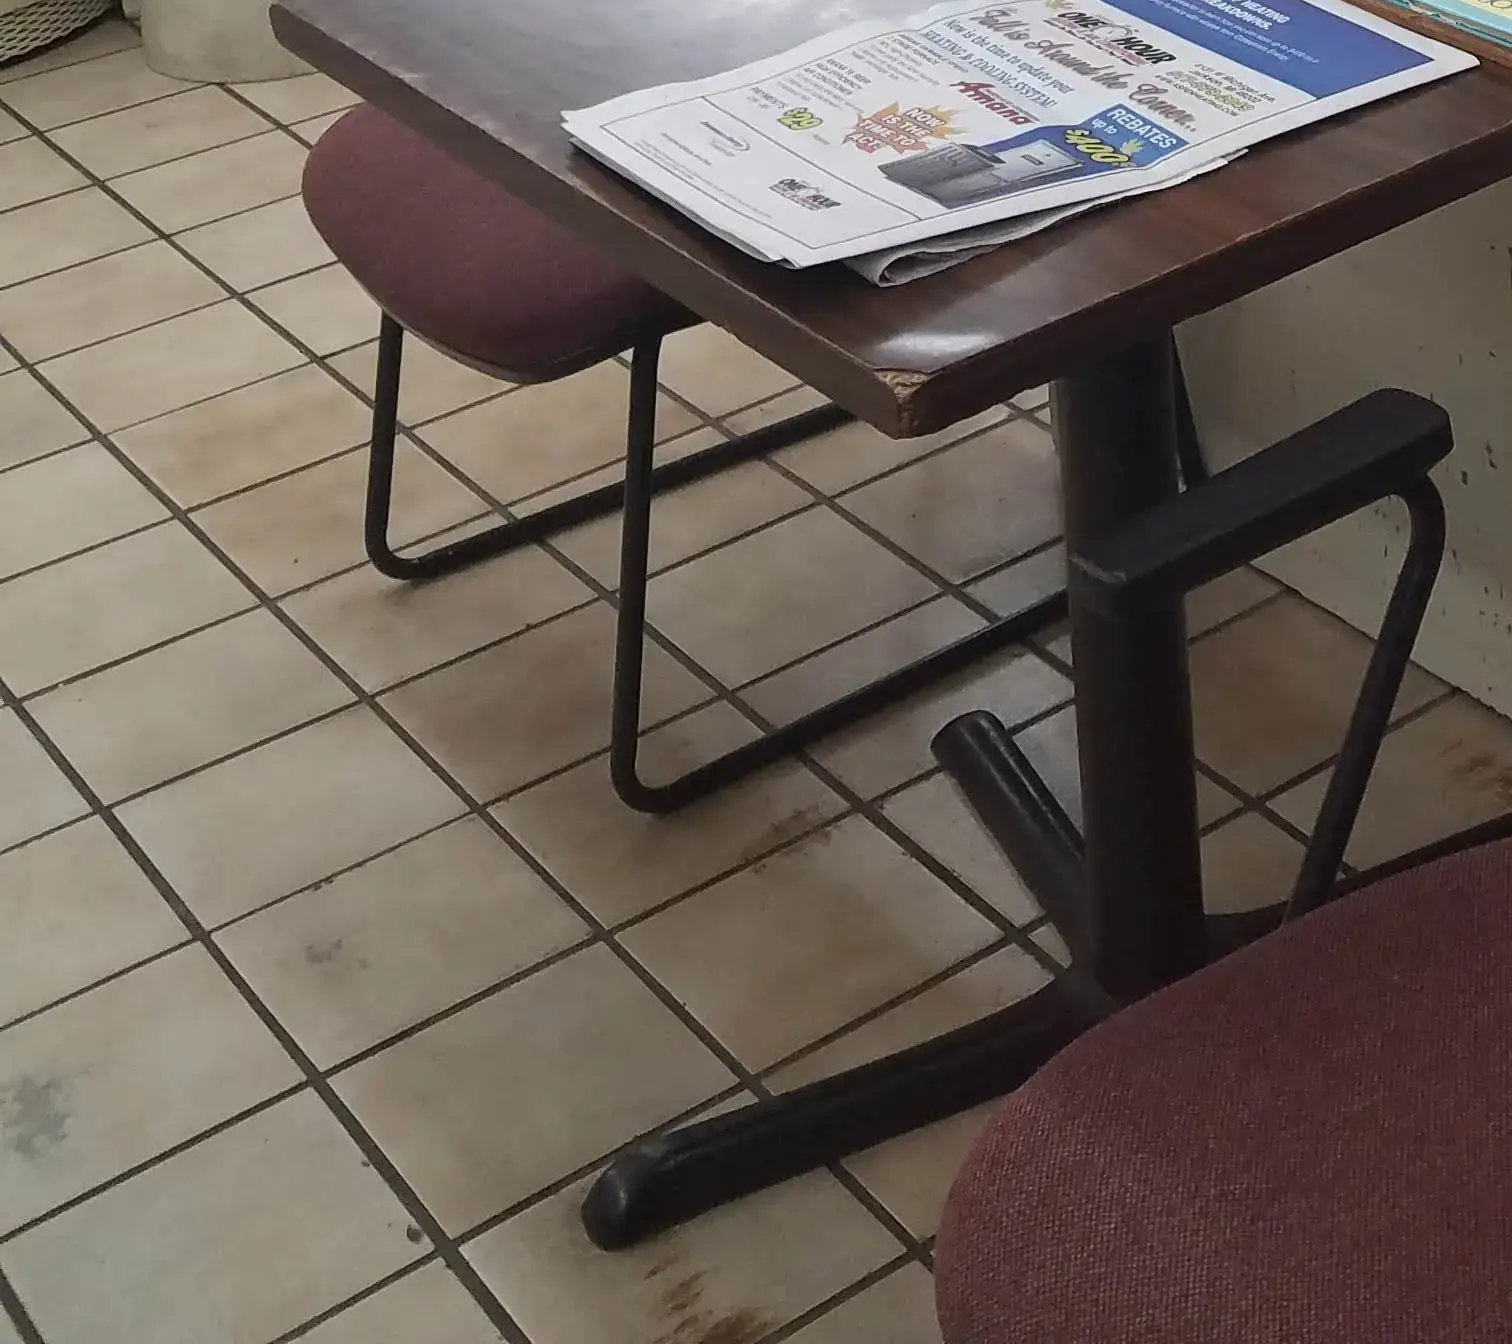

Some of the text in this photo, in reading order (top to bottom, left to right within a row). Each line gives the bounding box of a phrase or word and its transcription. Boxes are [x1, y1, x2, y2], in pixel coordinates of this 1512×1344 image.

[1240, 0, 1291, 24] HEATING
[1058, 11, 1107, 30] ONE
[1111, 37, 1177, 65] HOUR
[943, 18, 1076, 95] Now is the time to update your
[1024, 40, 1115, 77] Around
[1091, 72, 1135, 90] the
[968, 58, 1018, 88] COOLING
[906, 107, 945, 127] NOW
[949, 80, 1035, 126] Amana
[859, 120, 917, 146] TIME TO
[881, 114, 931, 138] IS THE
[1091, 118, 1118, 135] up to
[1106, 108, 1178, 149] REBATES
